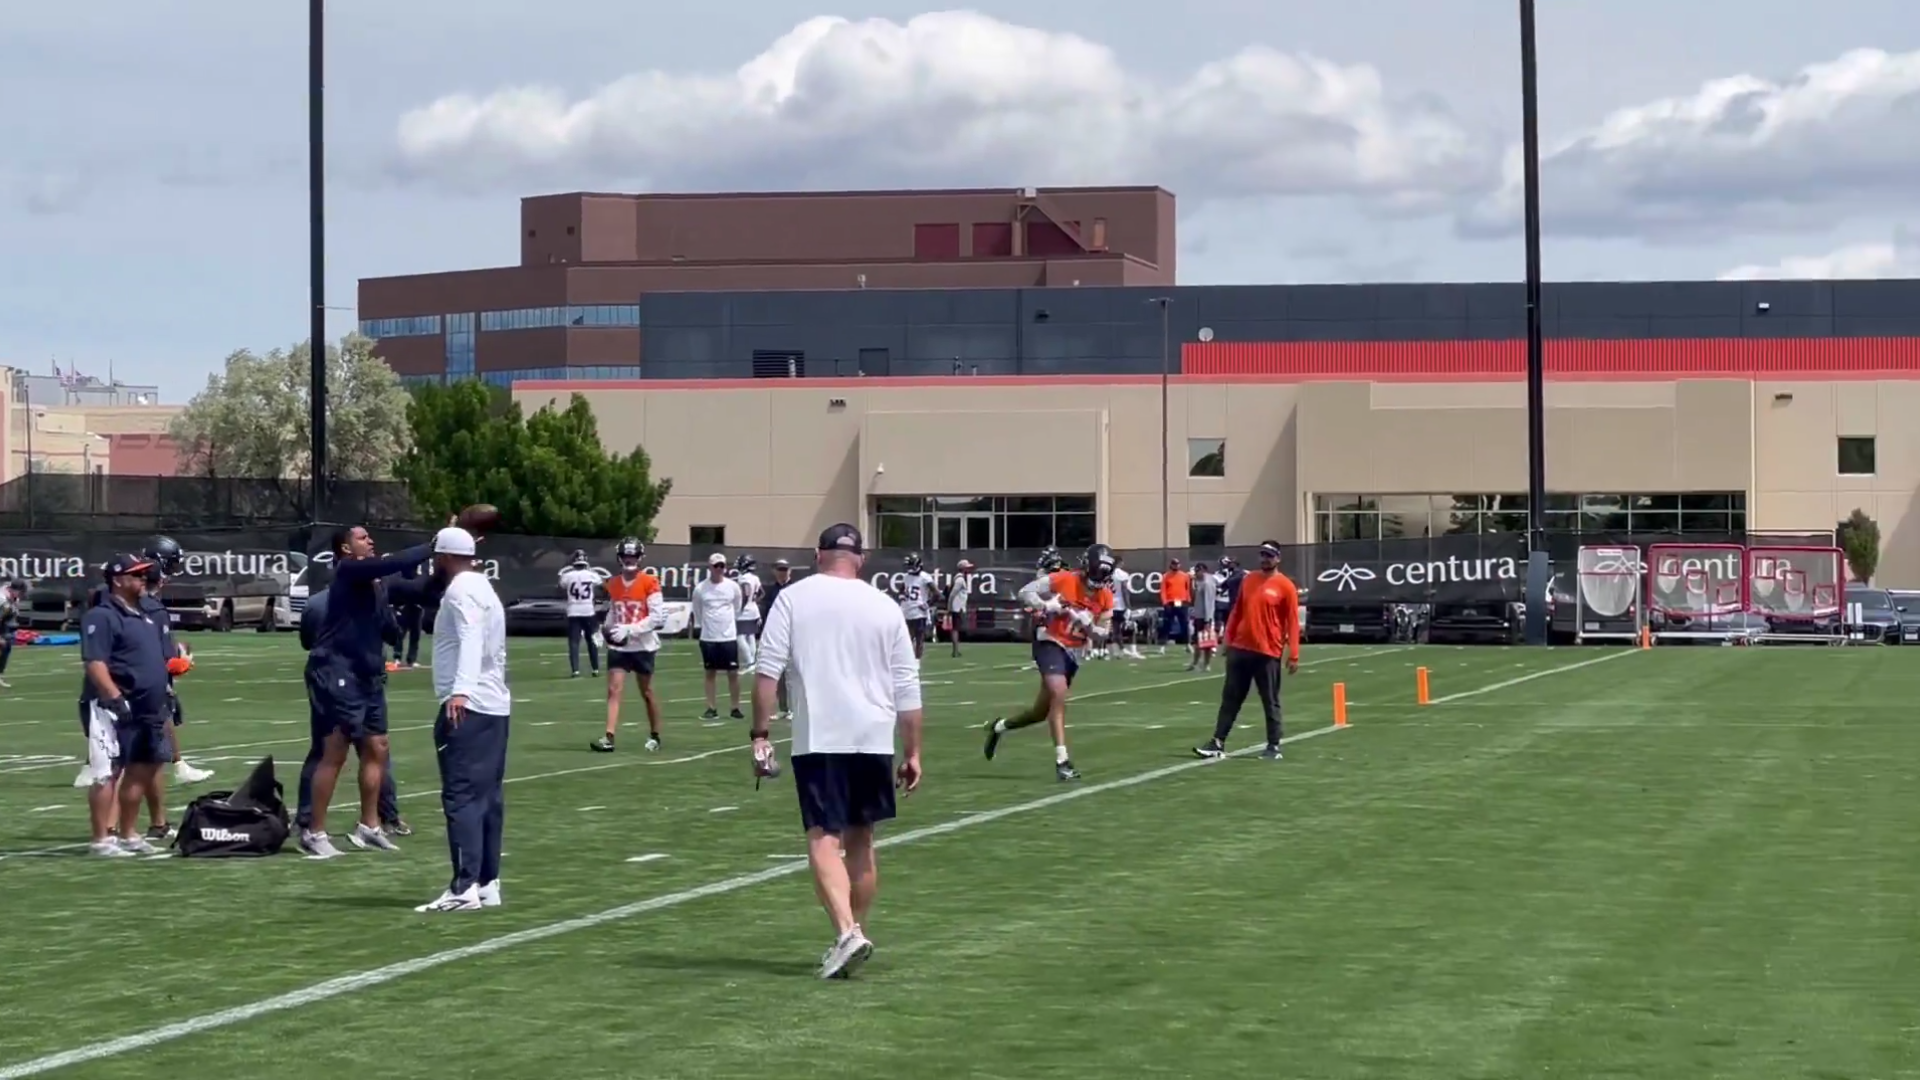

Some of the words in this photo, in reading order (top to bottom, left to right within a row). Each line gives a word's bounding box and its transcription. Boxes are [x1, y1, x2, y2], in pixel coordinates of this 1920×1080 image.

[173, 550, 290, 576] entura
[1386, 555, 1517, 585] centura
[1664, 553, 1794, 580] centra
[570, 581, 592, 600] 43
[201, 827, 250, 842] Wilson
